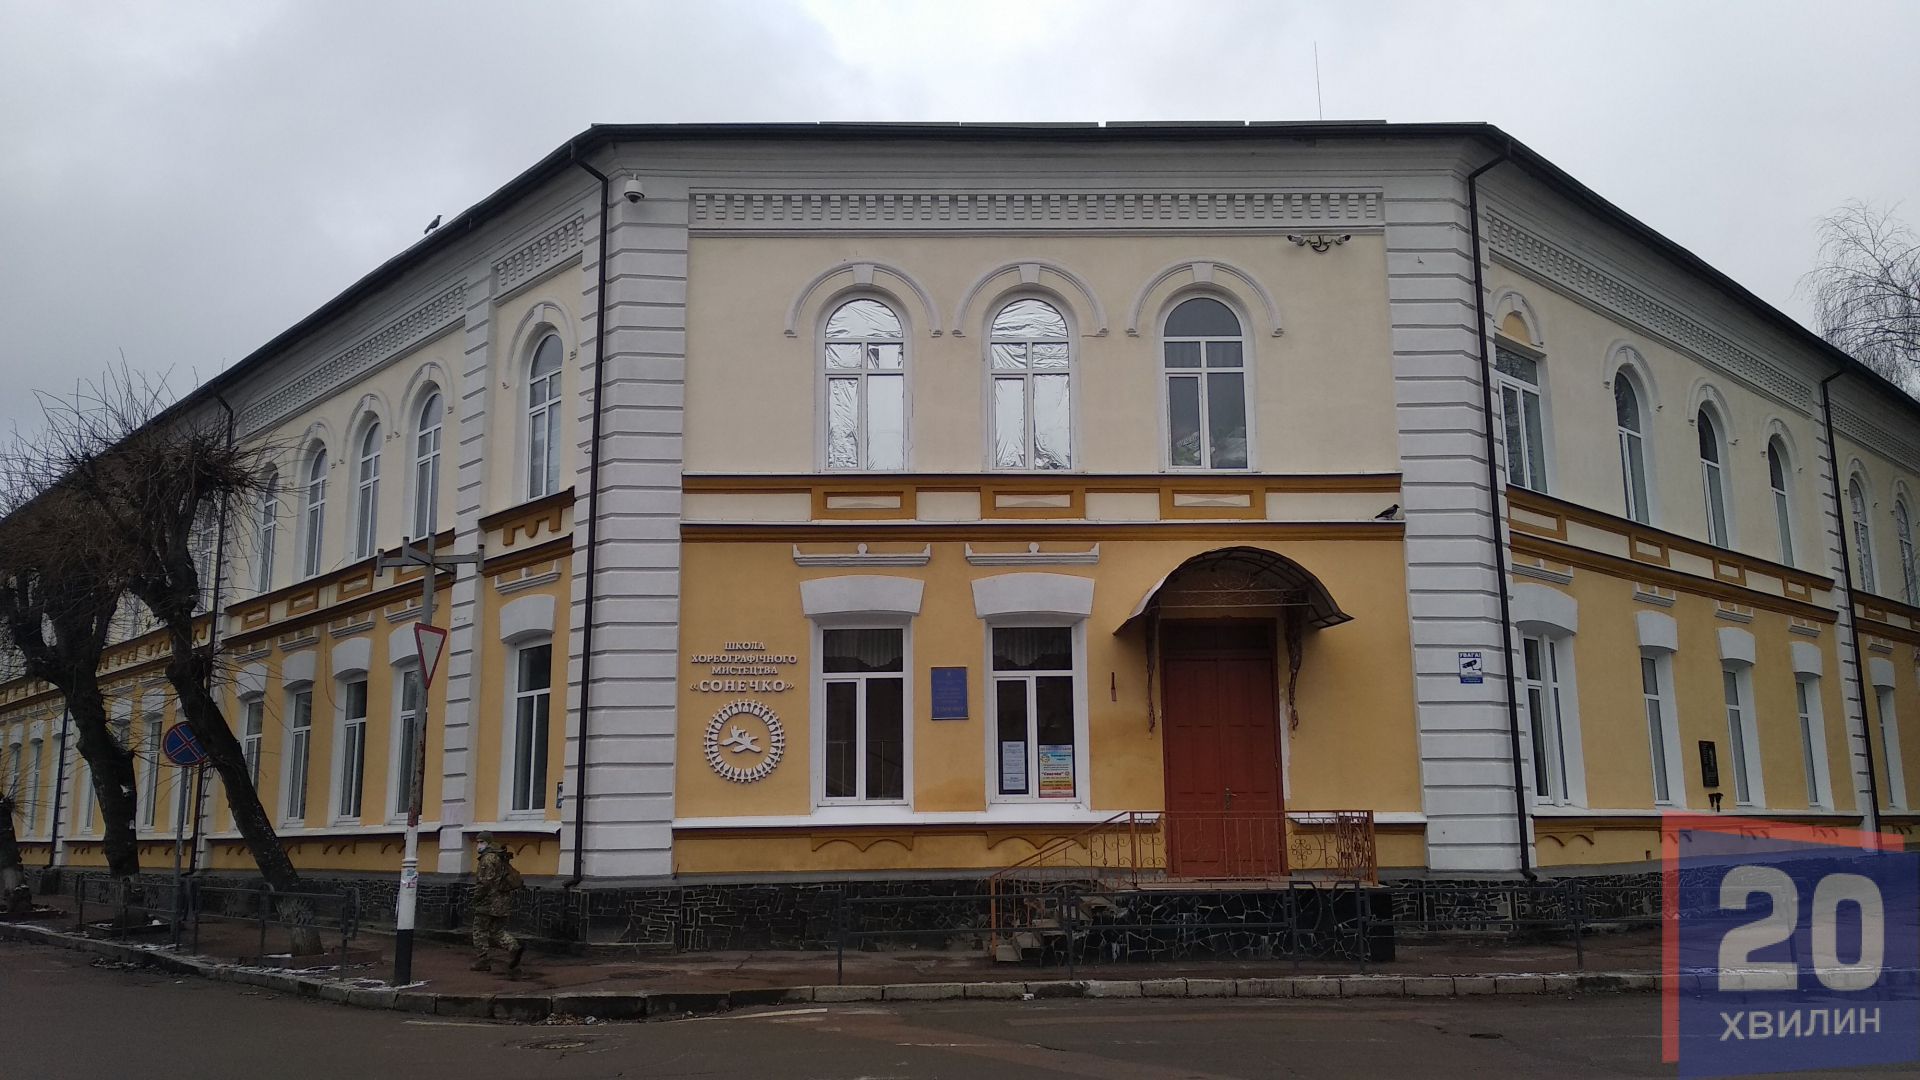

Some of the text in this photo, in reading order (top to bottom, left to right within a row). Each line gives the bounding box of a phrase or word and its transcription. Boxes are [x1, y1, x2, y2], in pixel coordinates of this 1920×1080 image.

[724, 641, 765, 650] ШКОЛА
[691, 654, 797, 664] ХОРЕОГРАФІЧНОГО
[711, 666, 778, 676] МИСТЕЦТВА
[690, 679, 794, 692] «СОНЕЧКО»
